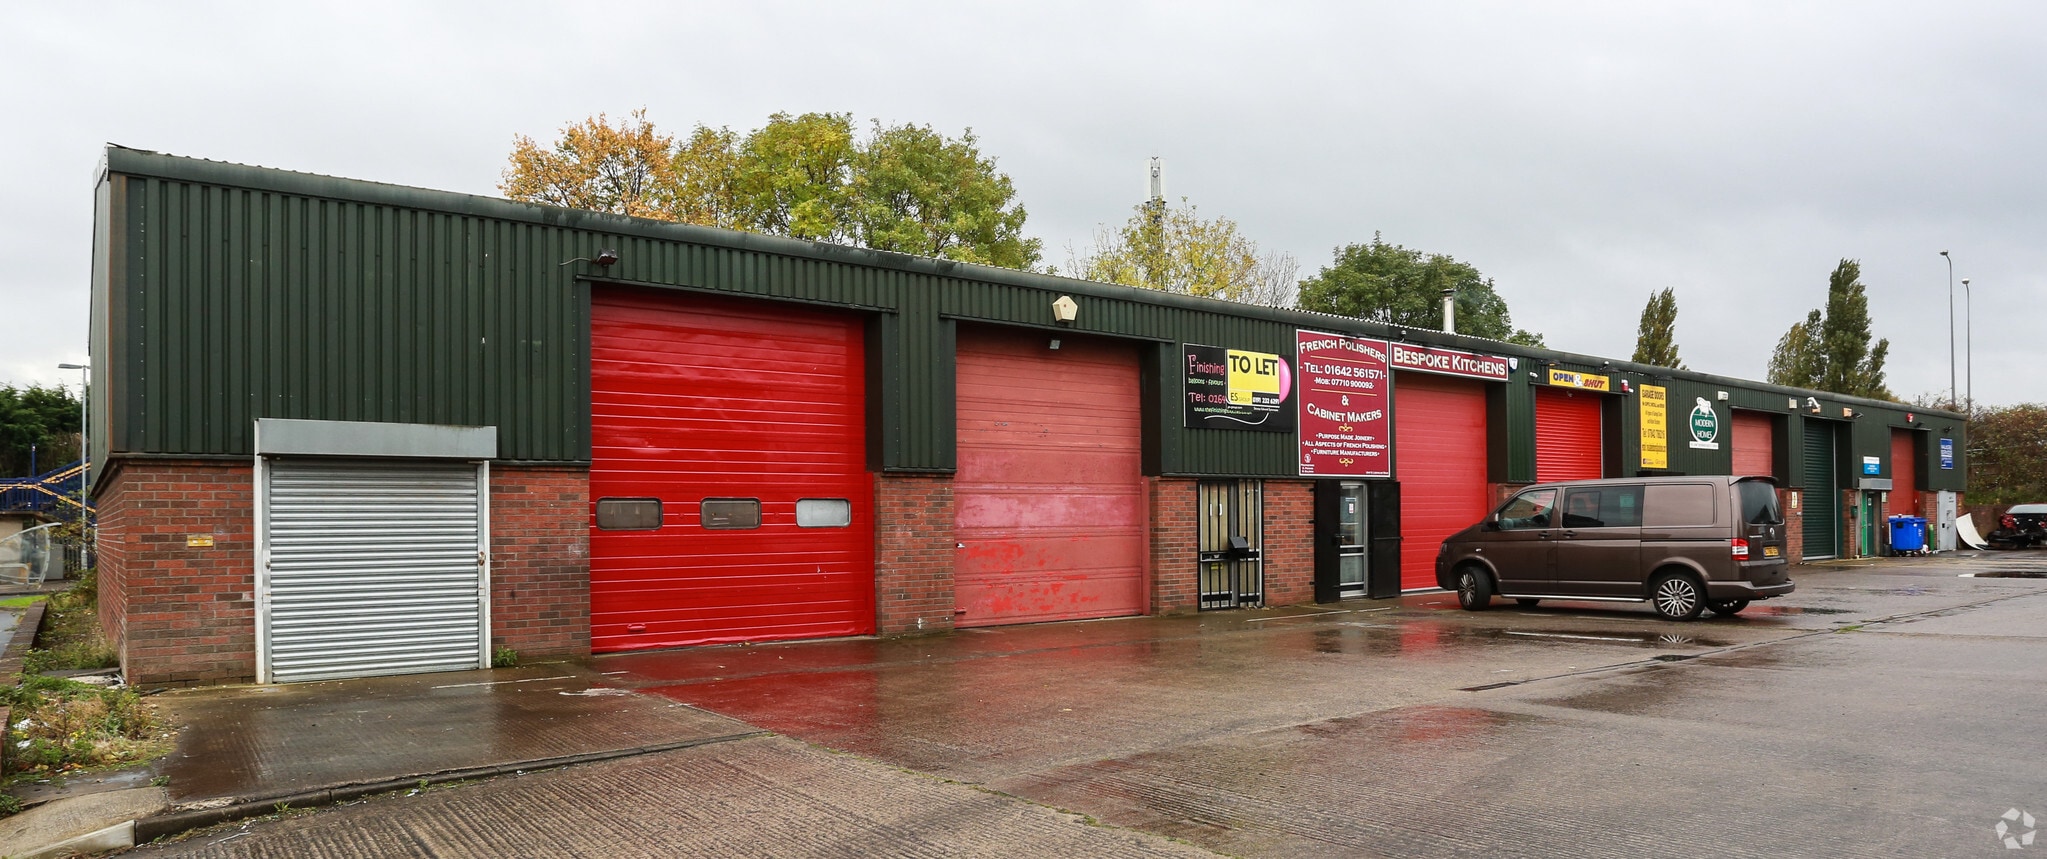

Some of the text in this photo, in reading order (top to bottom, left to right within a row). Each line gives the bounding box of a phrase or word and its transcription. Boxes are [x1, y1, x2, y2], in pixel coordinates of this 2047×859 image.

[1299, 338, 1386, 363] FRENCH POLISHERS
[1188, 354, 1225, 376] Finishing
[1229, 354, 1278, 376] TO LET
[1393, 346, 1506, 376] BESPOKE KITCHENS
[1324, 364, 1352, 377] 01642
[1331, 378, 1350, 387] 07710
[1553, 372, 1605, 389] OPEN & SHUT
[1188, 392, 1206, 403] Tel:
[1230, 392, 1239, 402] ES
[1341, 394, 1349, 406] &
[1307, 402, 1382, 422] CABINET MAKERS
[1694, 418, 1714, 427] MODERN
[1318, 432, 1340, 440] PURPOSE
[1340, 433, 1354, 441] MADE
[1696, 430, 1713, 439] HOMES
[1315, 440, 1336, 448] ASPECTS
[1343, 441, 1362, 449] FRENCH
